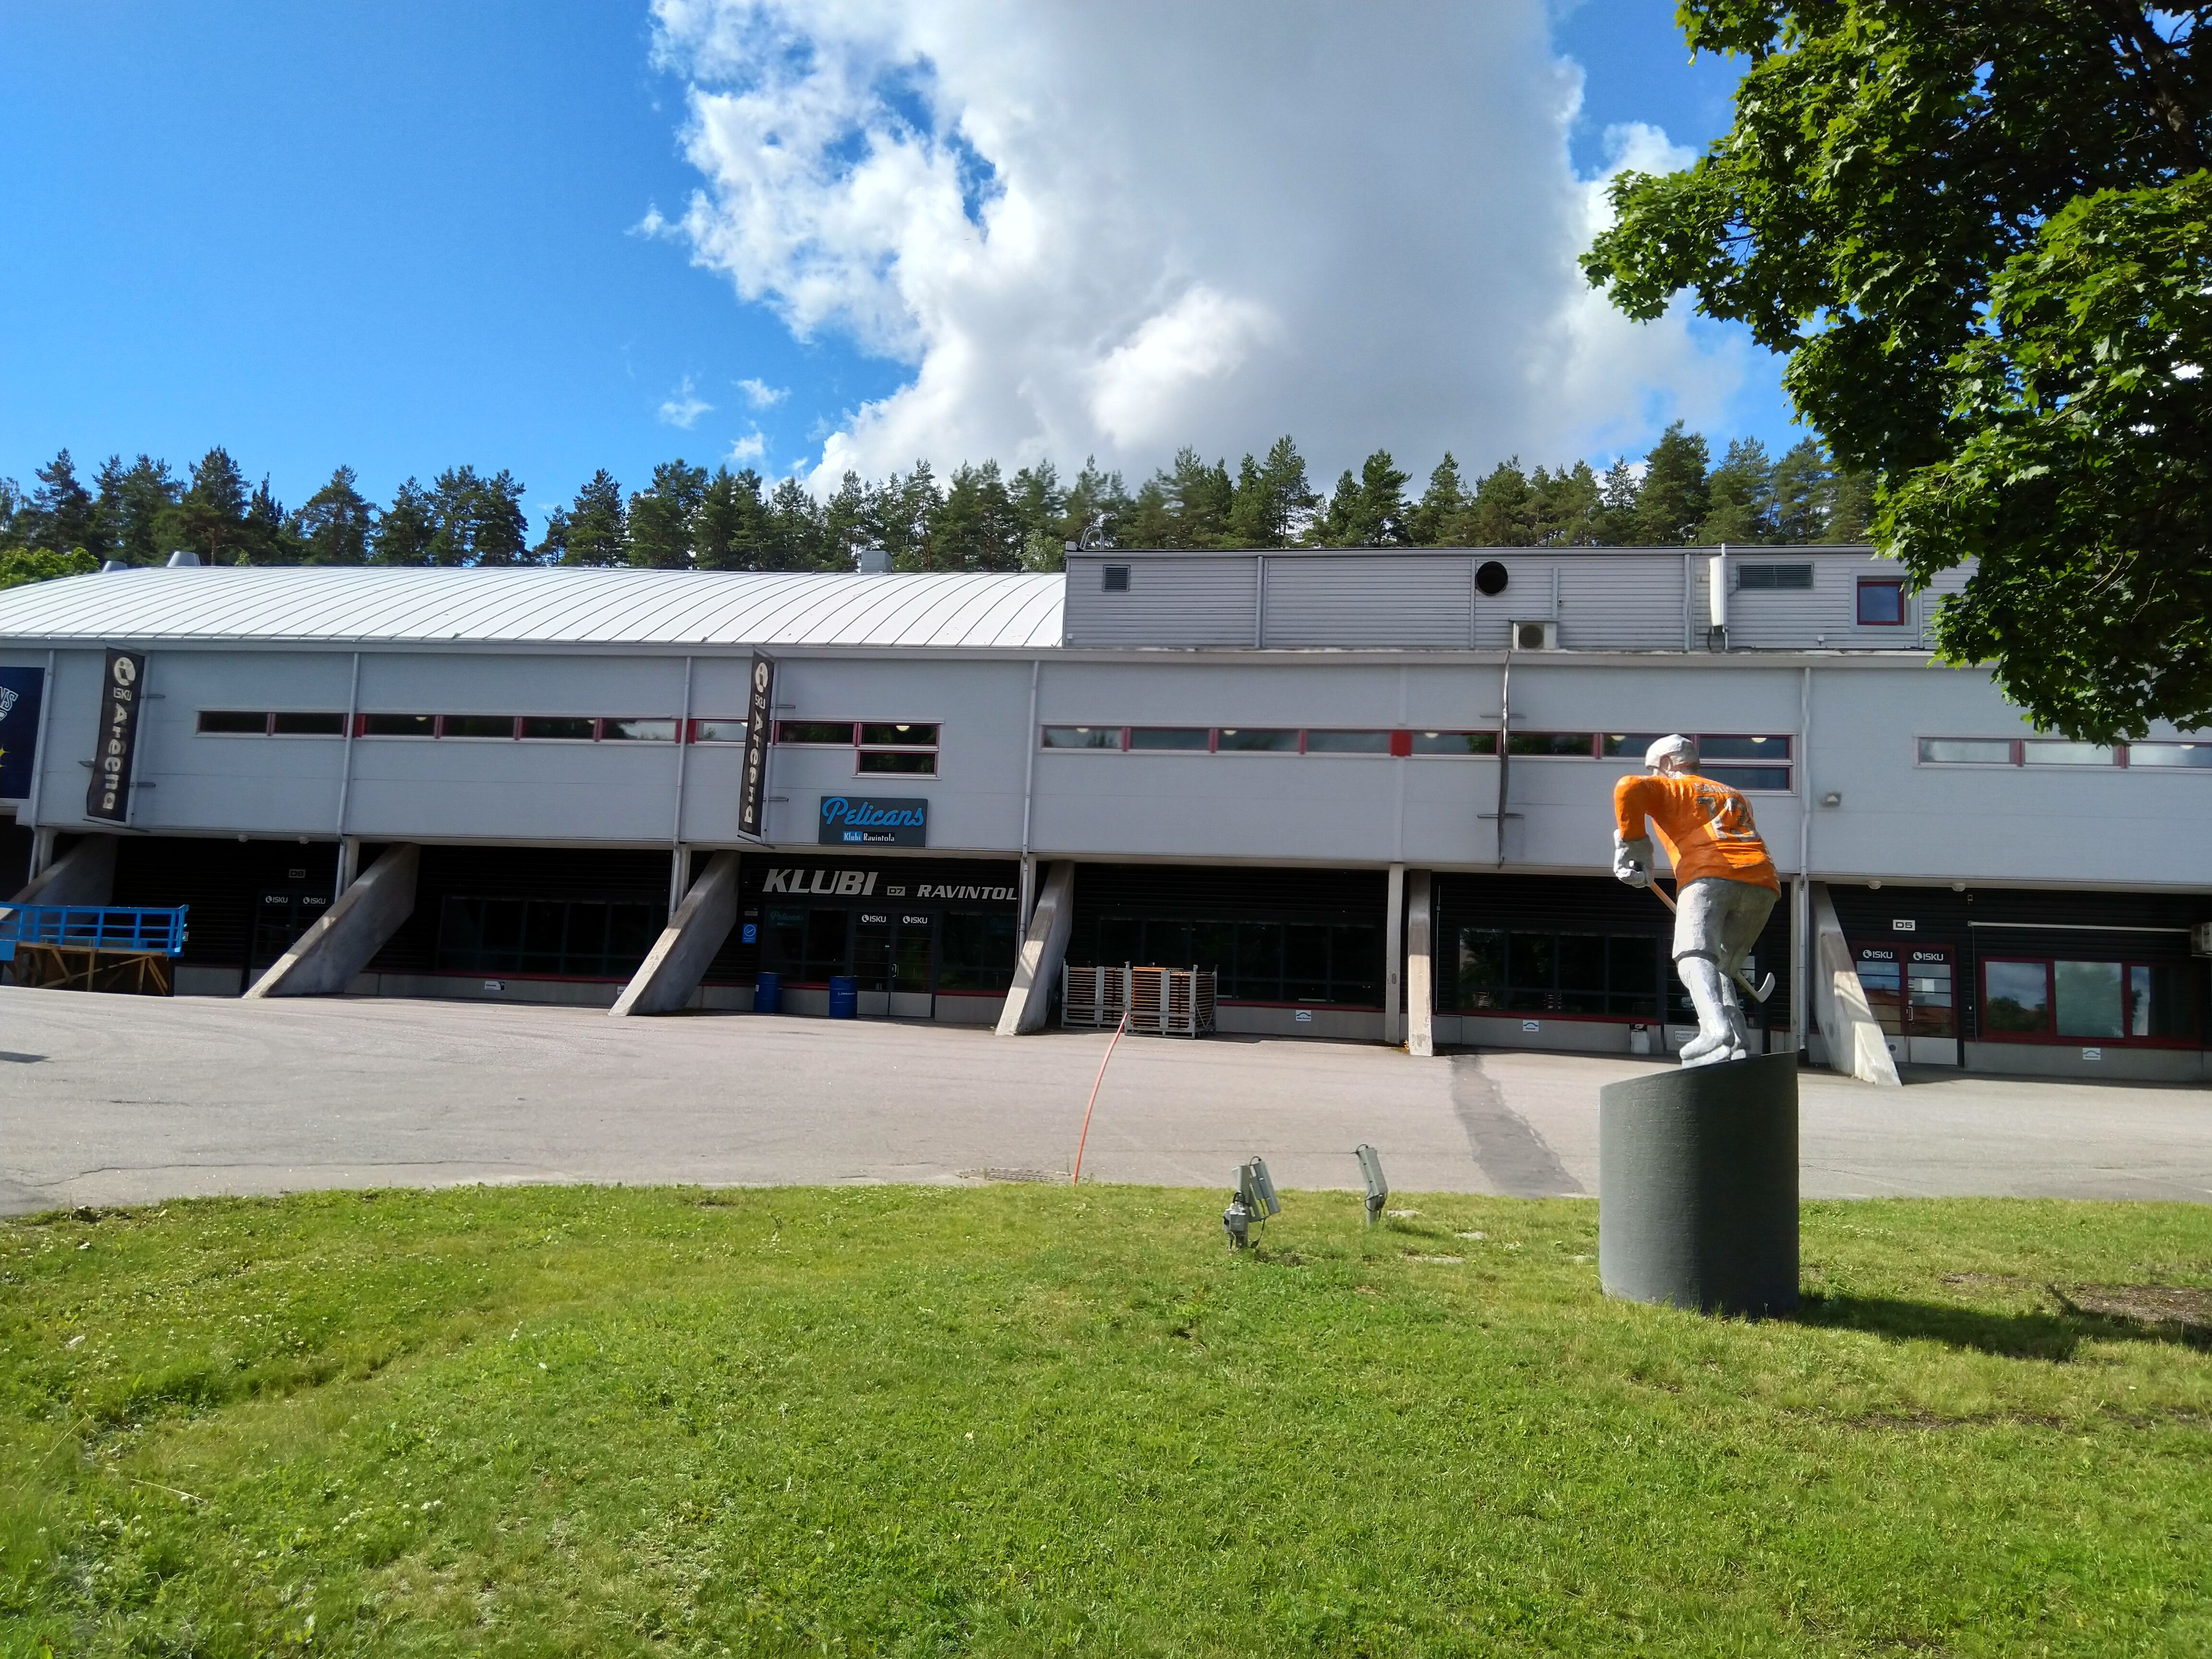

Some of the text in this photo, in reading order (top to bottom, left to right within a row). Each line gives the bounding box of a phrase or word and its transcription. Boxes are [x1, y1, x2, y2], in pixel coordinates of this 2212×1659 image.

[113, 687, 132, 701] ISKU
[103, 702, 128, 810] Areena
[744, 709, 763, 824] Areena
[822, 797, 924, 827] Pelicans
[844, 832, 895, 842] Klubi Ravintola
[762, 869, 878, 895] KLUBI
[917, 885, 1019, 900] RAVINTOL
[1923, 953, 1944, 961] ISKU
